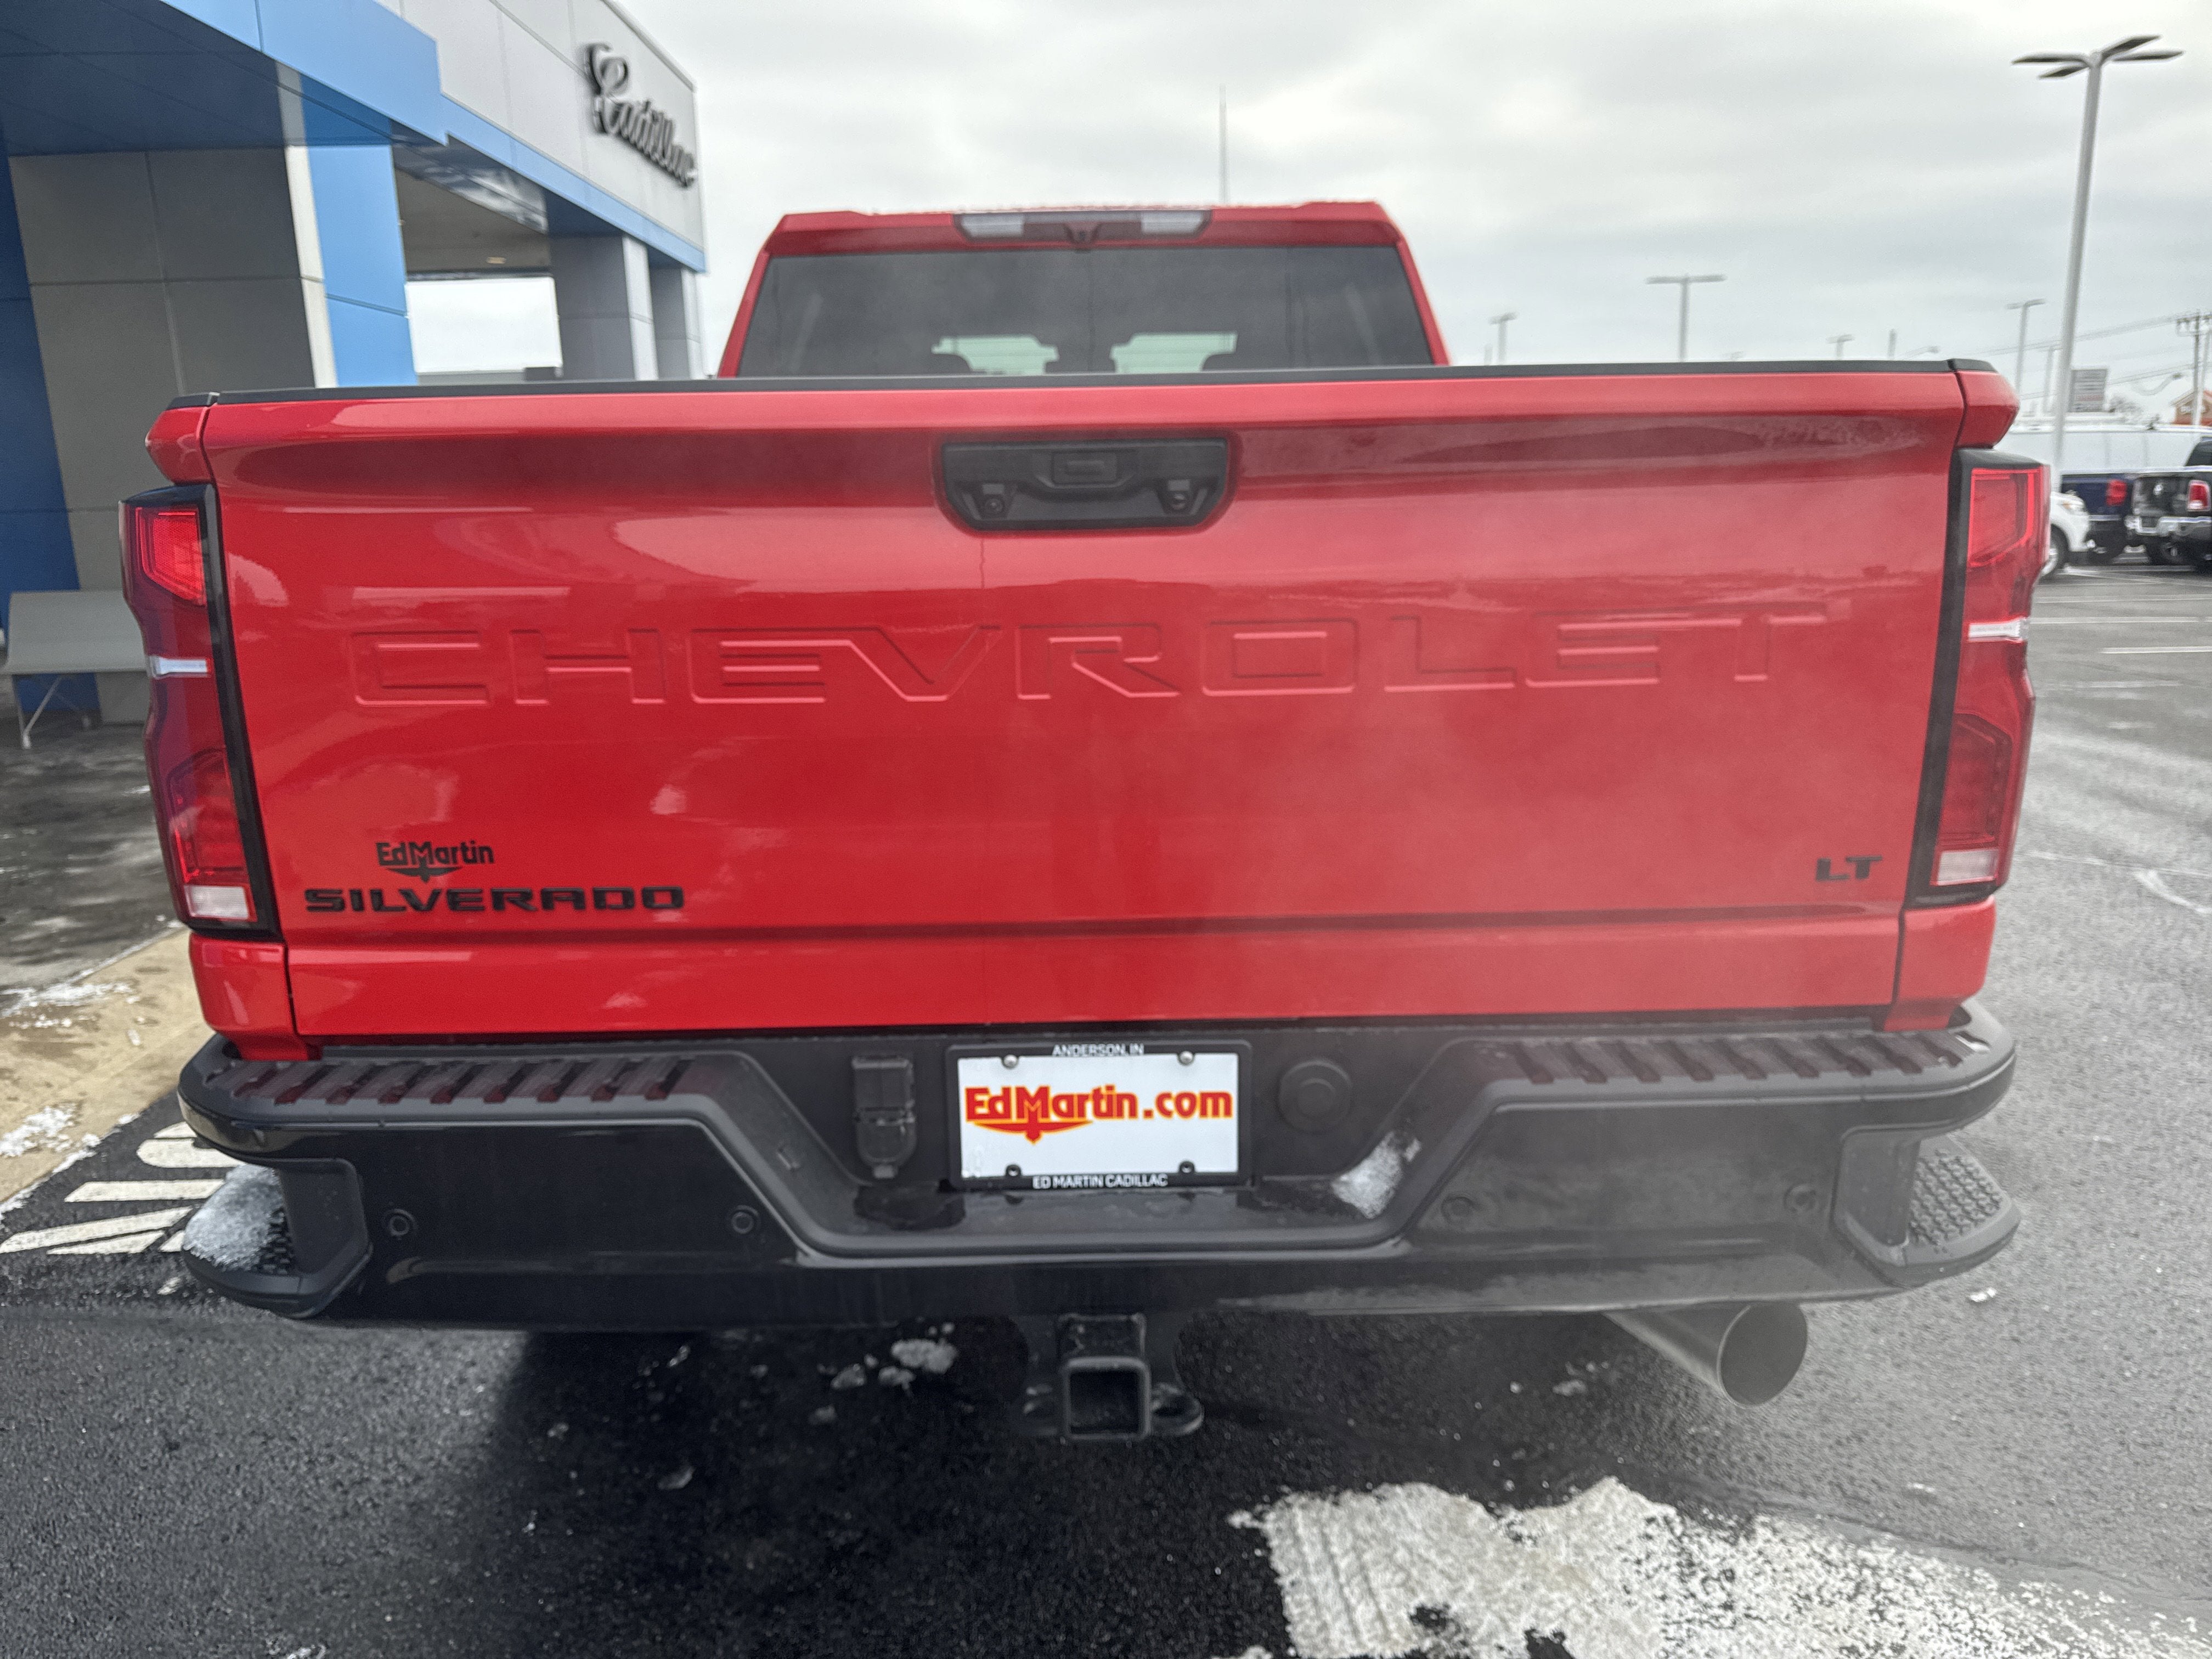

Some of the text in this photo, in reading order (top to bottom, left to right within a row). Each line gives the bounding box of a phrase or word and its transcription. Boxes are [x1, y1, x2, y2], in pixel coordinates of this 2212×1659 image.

[351, 600, 1827, 707] CHEVROLET
[375, 840, 495, 867] EdMartin
[1815, 855, 1883, 882] LT
[304, 885, 685, 913] SILVERADO
[1129, 1042, 1144, 1056] IN
[964, 1084, 1234, 1122] EdMartin.com
[1032, 1173, 1168, 1189] ED MARTIN CADILLAC
